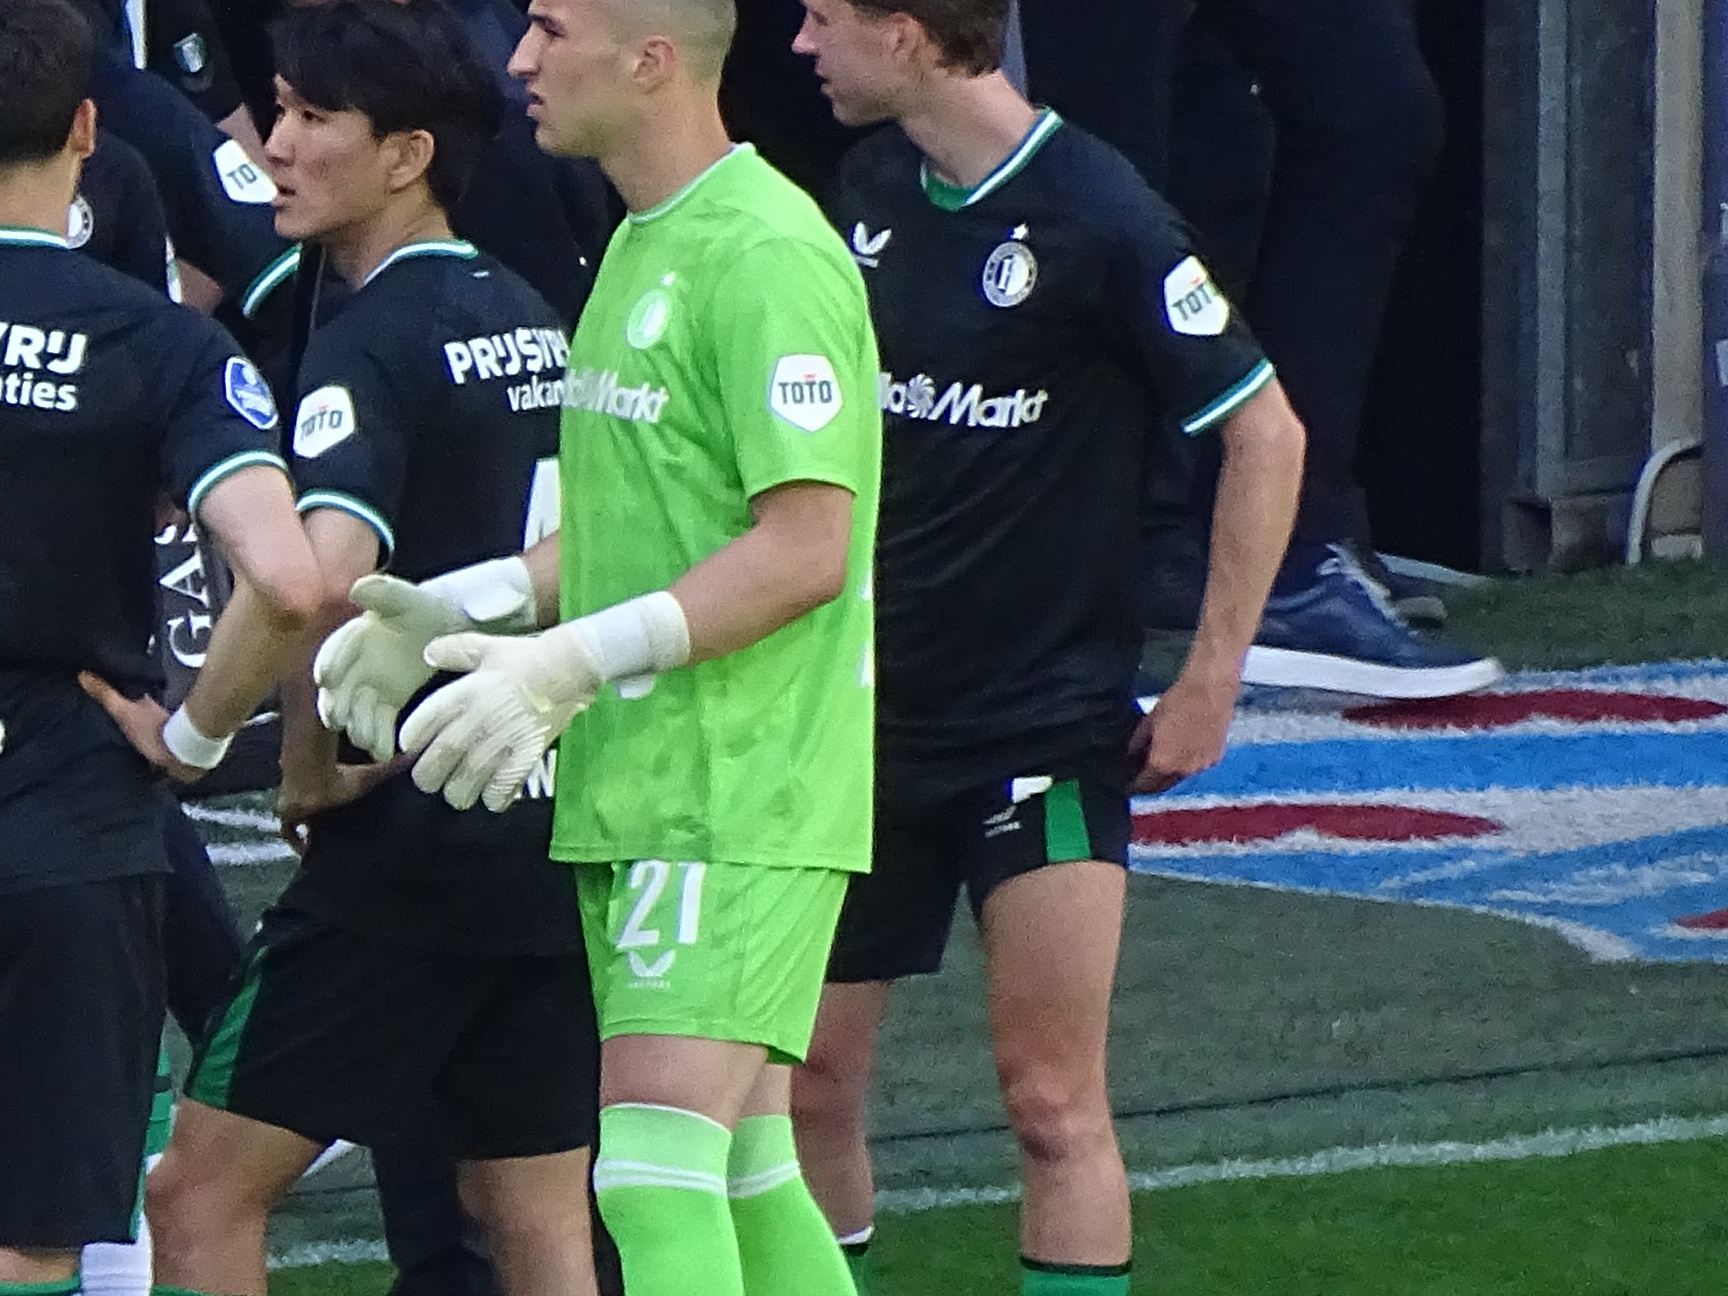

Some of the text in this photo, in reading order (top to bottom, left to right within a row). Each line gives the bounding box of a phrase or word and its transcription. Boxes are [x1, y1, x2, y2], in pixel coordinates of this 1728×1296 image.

[1172, 281, 1213, 322] TOT
[777, 379, 835, 406] TOTO
[615, 859, 707, 950] 21
